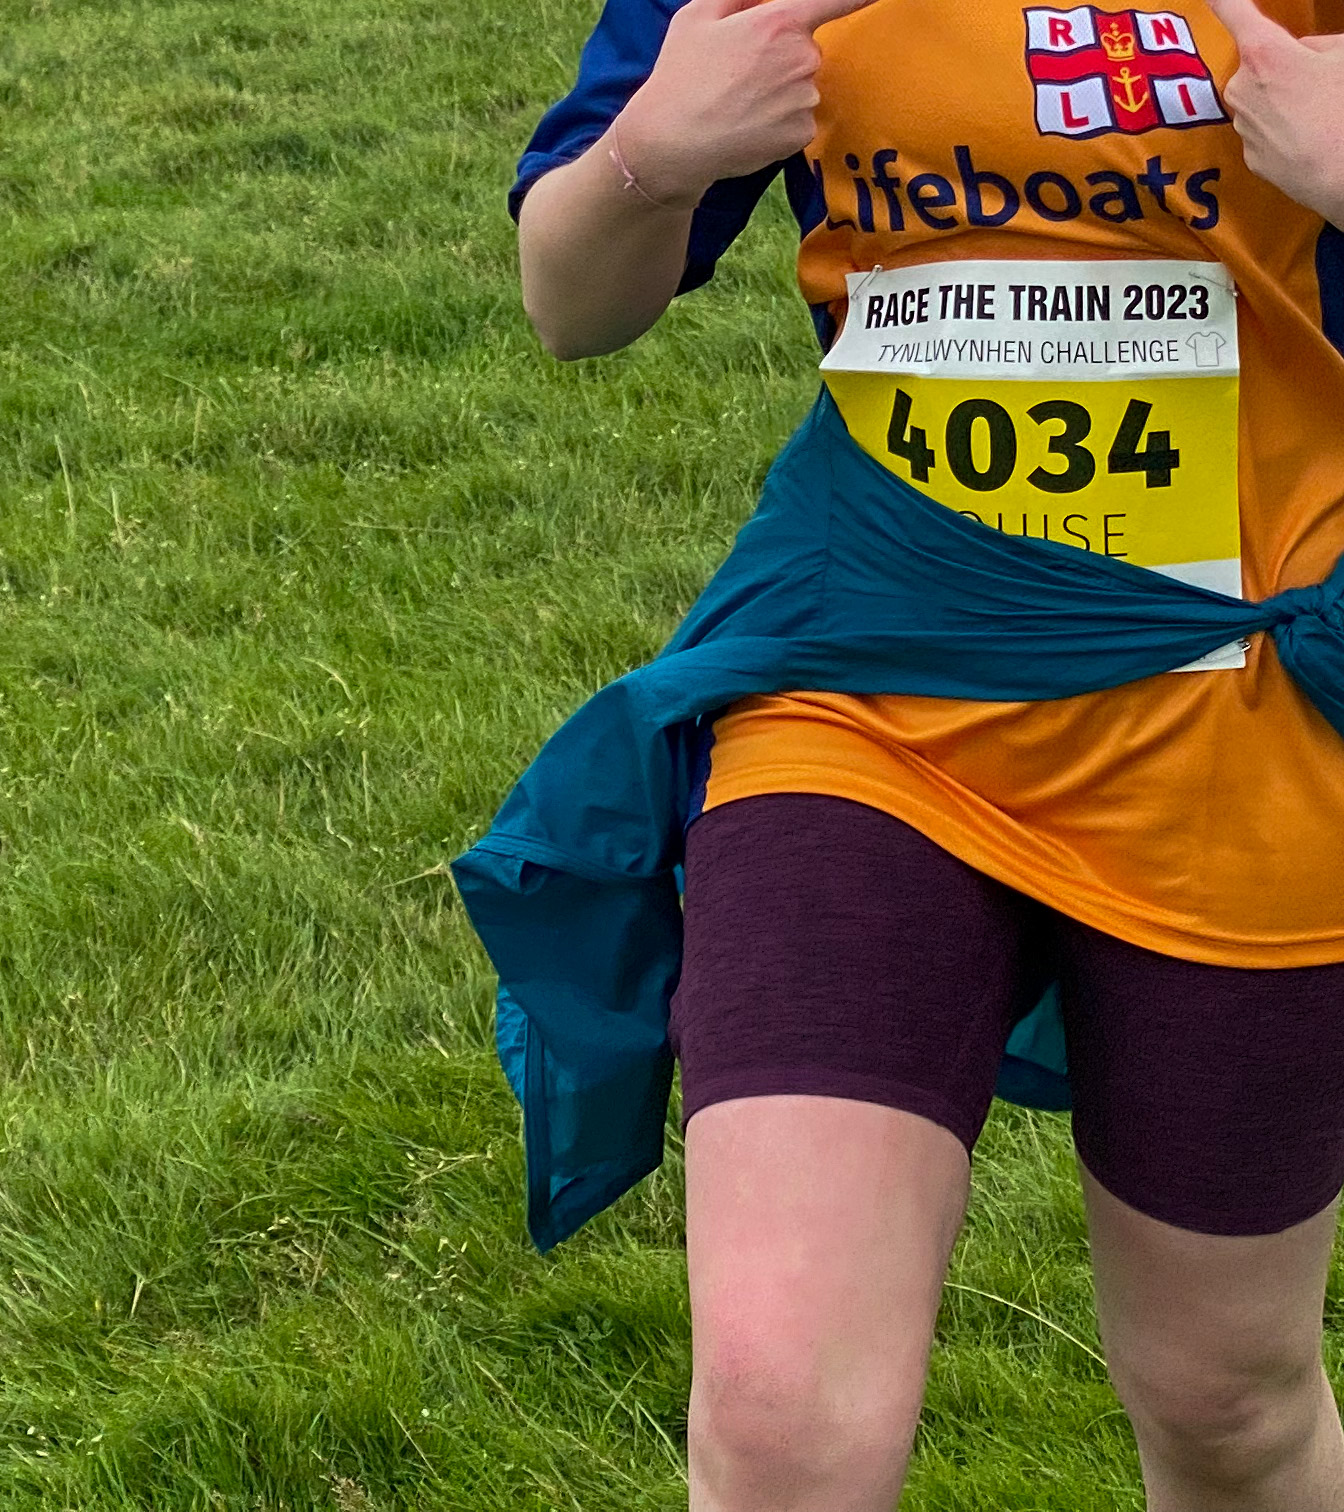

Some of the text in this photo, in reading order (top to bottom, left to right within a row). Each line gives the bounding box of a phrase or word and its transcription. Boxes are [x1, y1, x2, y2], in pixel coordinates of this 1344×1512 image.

[1047, 16, 1180, 48] R N
[1060, 83, 1197, 128] L I
[813, 145, 1222, 234] Lifeboats
[865, 284, 1210, 330] RACE THE TRAIN 2023
[877, 339, 1180, 365] TYNLLWYNHEN CHALLENGE
[886, 388, 1180, 494] 4034
[957, 510, 1128, 557] ISE
